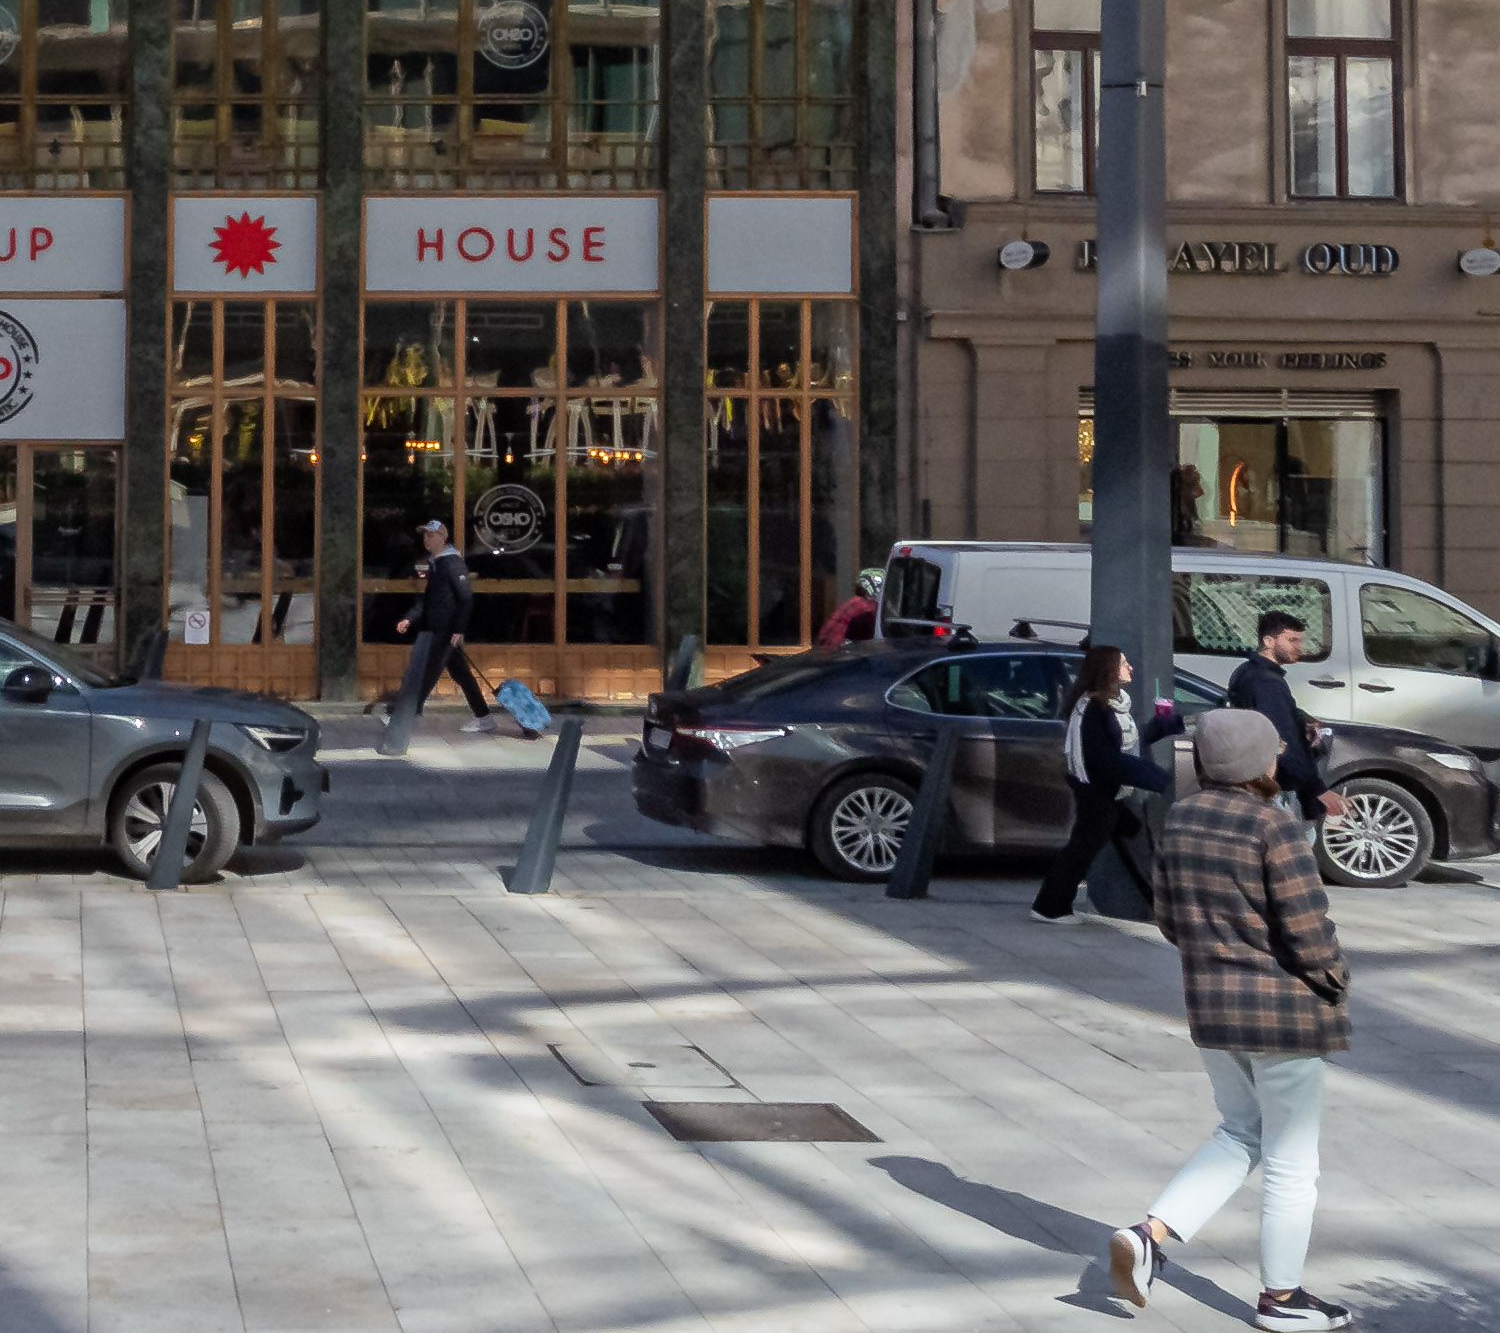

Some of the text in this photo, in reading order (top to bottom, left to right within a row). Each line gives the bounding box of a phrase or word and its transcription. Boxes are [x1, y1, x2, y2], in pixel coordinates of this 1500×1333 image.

[416, 226, 606, 263] HOUSE
[1302, 241, 1400, 276] OUD
[1208, 351, 1268, 369] YOUR
[1279, 352, 1387, 370] FEELINGS
[489, 512, 531, 526] OSHO
